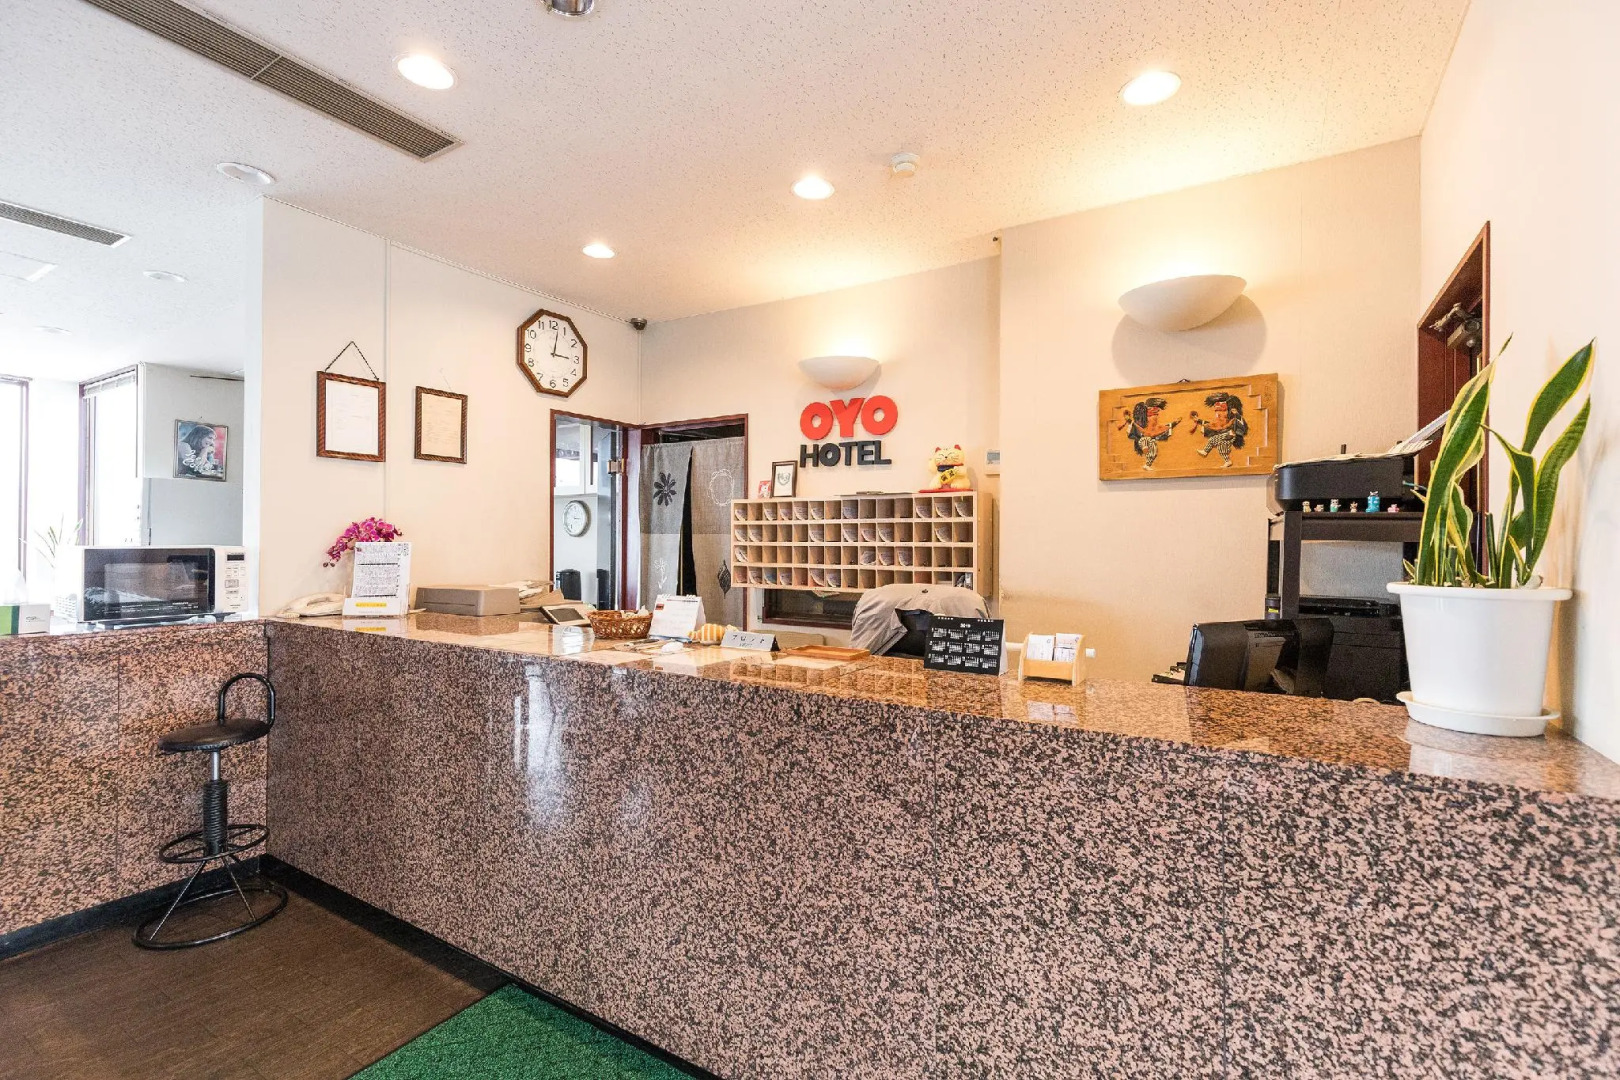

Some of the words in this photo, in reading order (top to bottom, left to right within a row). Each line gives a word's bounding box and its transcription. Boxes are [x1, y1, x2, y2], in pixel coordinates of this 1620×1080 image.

[538, 320, 545, 330] 11
[549, 320, 558, 330] 12
[527, 329, 537, 339] 10
[524, 343, 531, 352] 9
[570, 339, 578, 348] 2
[528, 358, 535, 367] 8
[573, 355, 580, 364] 3
[537, 372, 544, 381] 7
[549, 379, 556, 388] 6
[562, 378, 569, 387] 5
[800, 395, 898, 440] OYO
[799, 440, 892, 468] HOTEL
